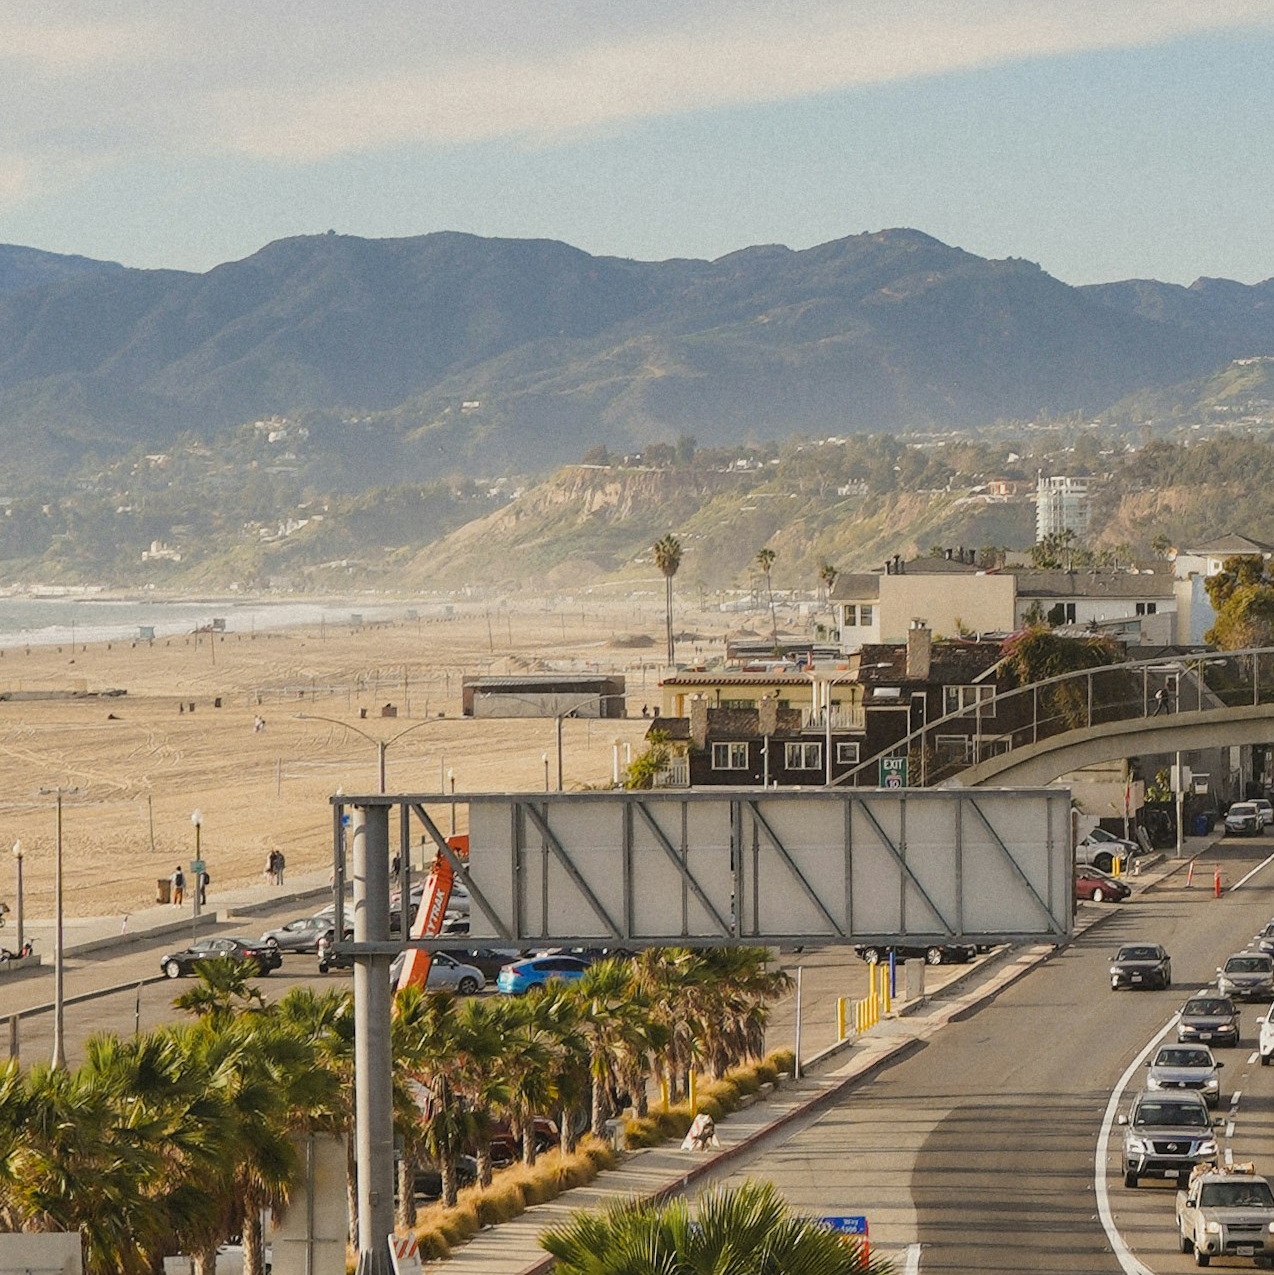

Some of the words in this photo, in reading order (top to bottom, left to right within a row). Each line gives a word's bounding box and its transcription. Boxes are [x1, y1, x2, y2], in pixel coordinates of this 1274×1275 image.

[883, 758, 903, 770] EXIT
[889, 779, 900, 788] 10
[425, 887, 446, 933] YTRAK
